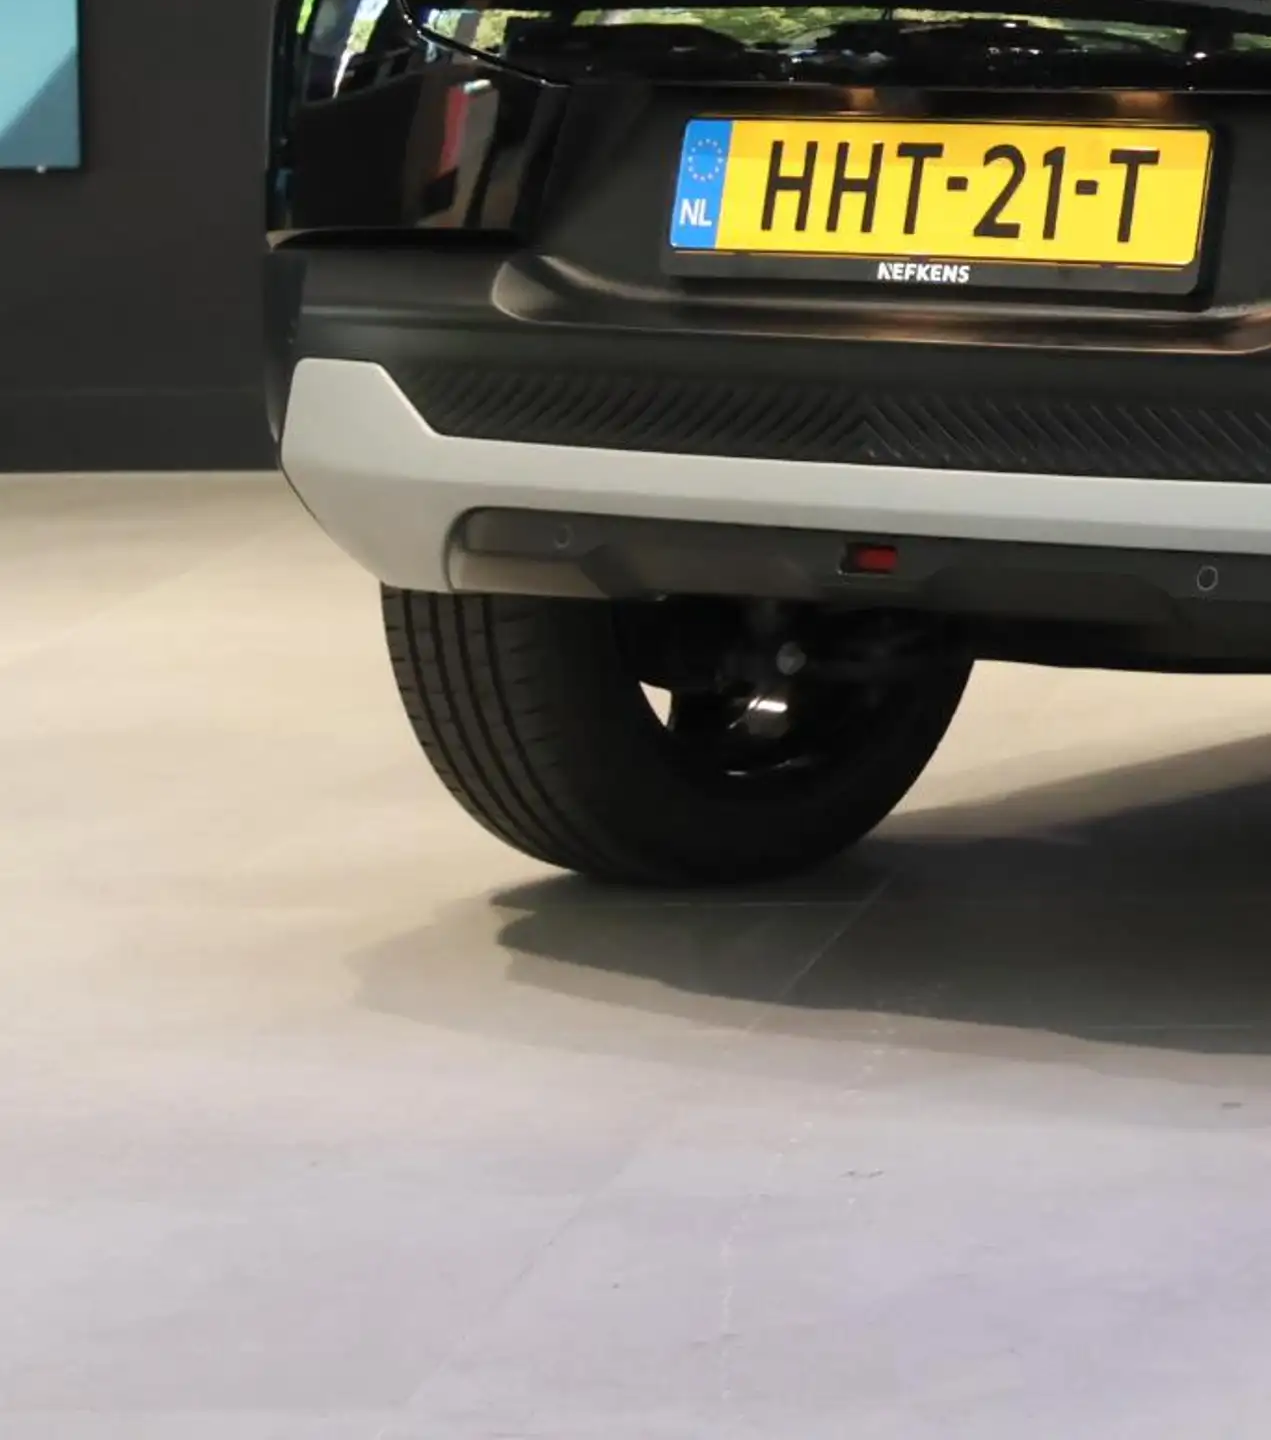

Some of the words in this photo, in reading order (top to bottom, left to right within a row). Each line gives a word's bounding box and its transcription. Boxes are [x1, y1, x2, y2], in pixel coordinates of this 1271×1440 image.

[760, 140, 1160, 243] HHT-21-T
[679, 198, 713, 227] NL
[877, 261, 971, 283] NEFKENS
